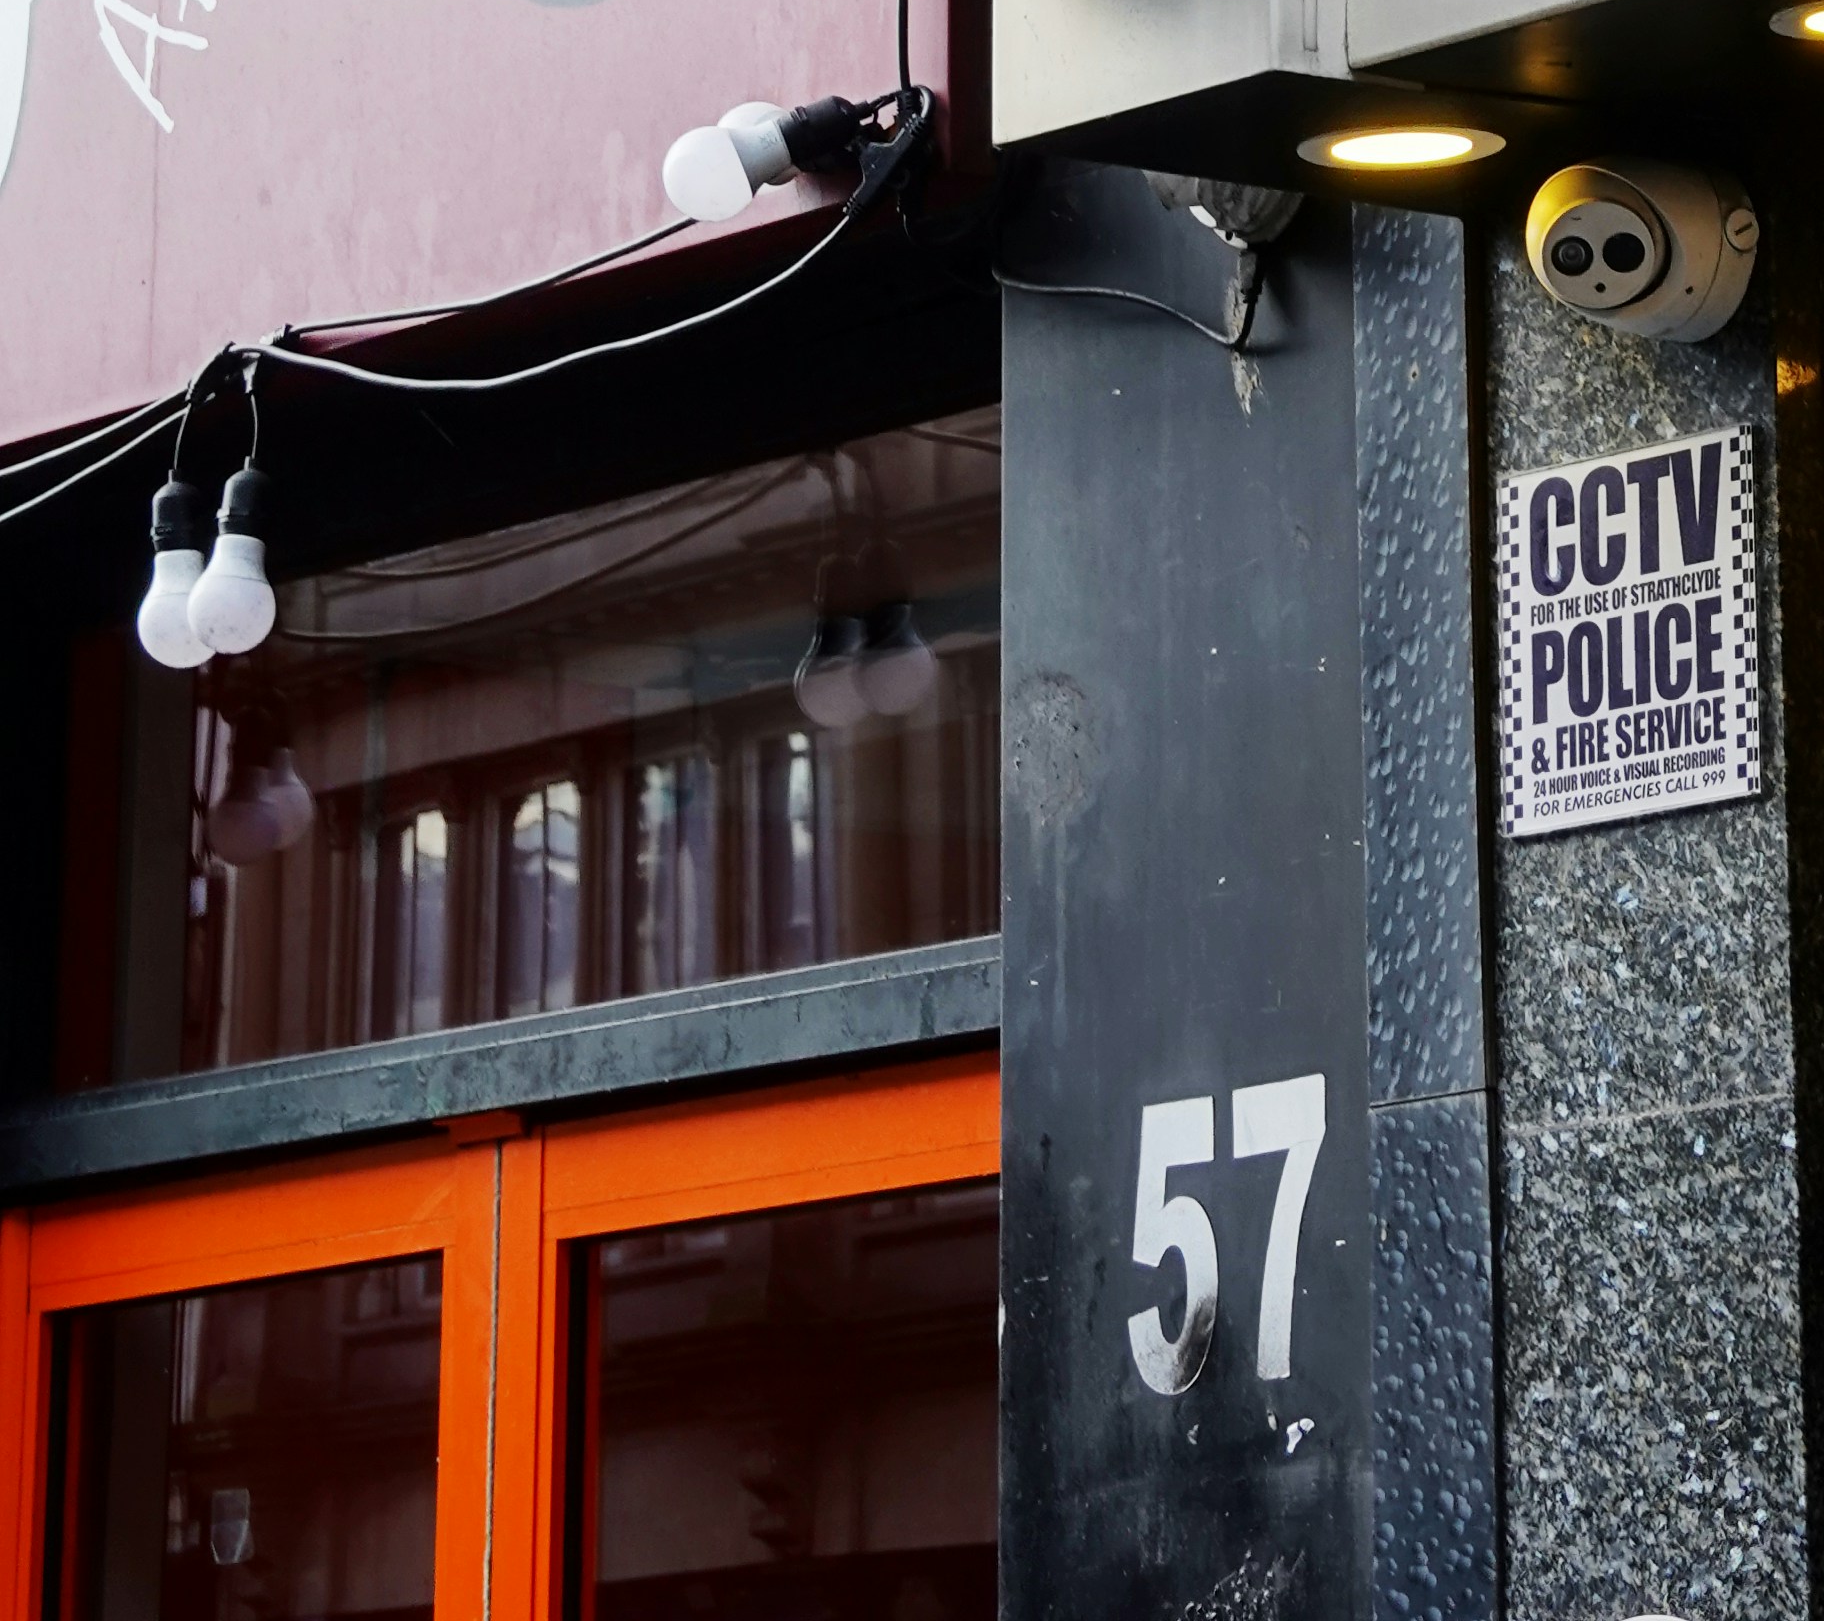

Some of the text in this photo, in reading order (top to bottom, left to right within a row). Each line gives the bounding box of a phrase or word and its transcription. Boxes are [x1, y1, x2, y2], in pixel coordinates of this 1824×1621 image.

[1530, 441, 1723, 596] CCTV
[1531, 567, 1722, 627] FOR THE USE OF STRATHCLYDE
[1531, 595, 1725, 725] POLICE
[1531, 695, 1727, 775] & FIRE SERVICE
[1533, 747, 1726, 799] 24 HOUR VOICE & VISUAL RECORDING
[1533, 770, 1726, 818] FOR EMERGENCIES CALL 999
[1127, 1072, 1327, 1396] 57
